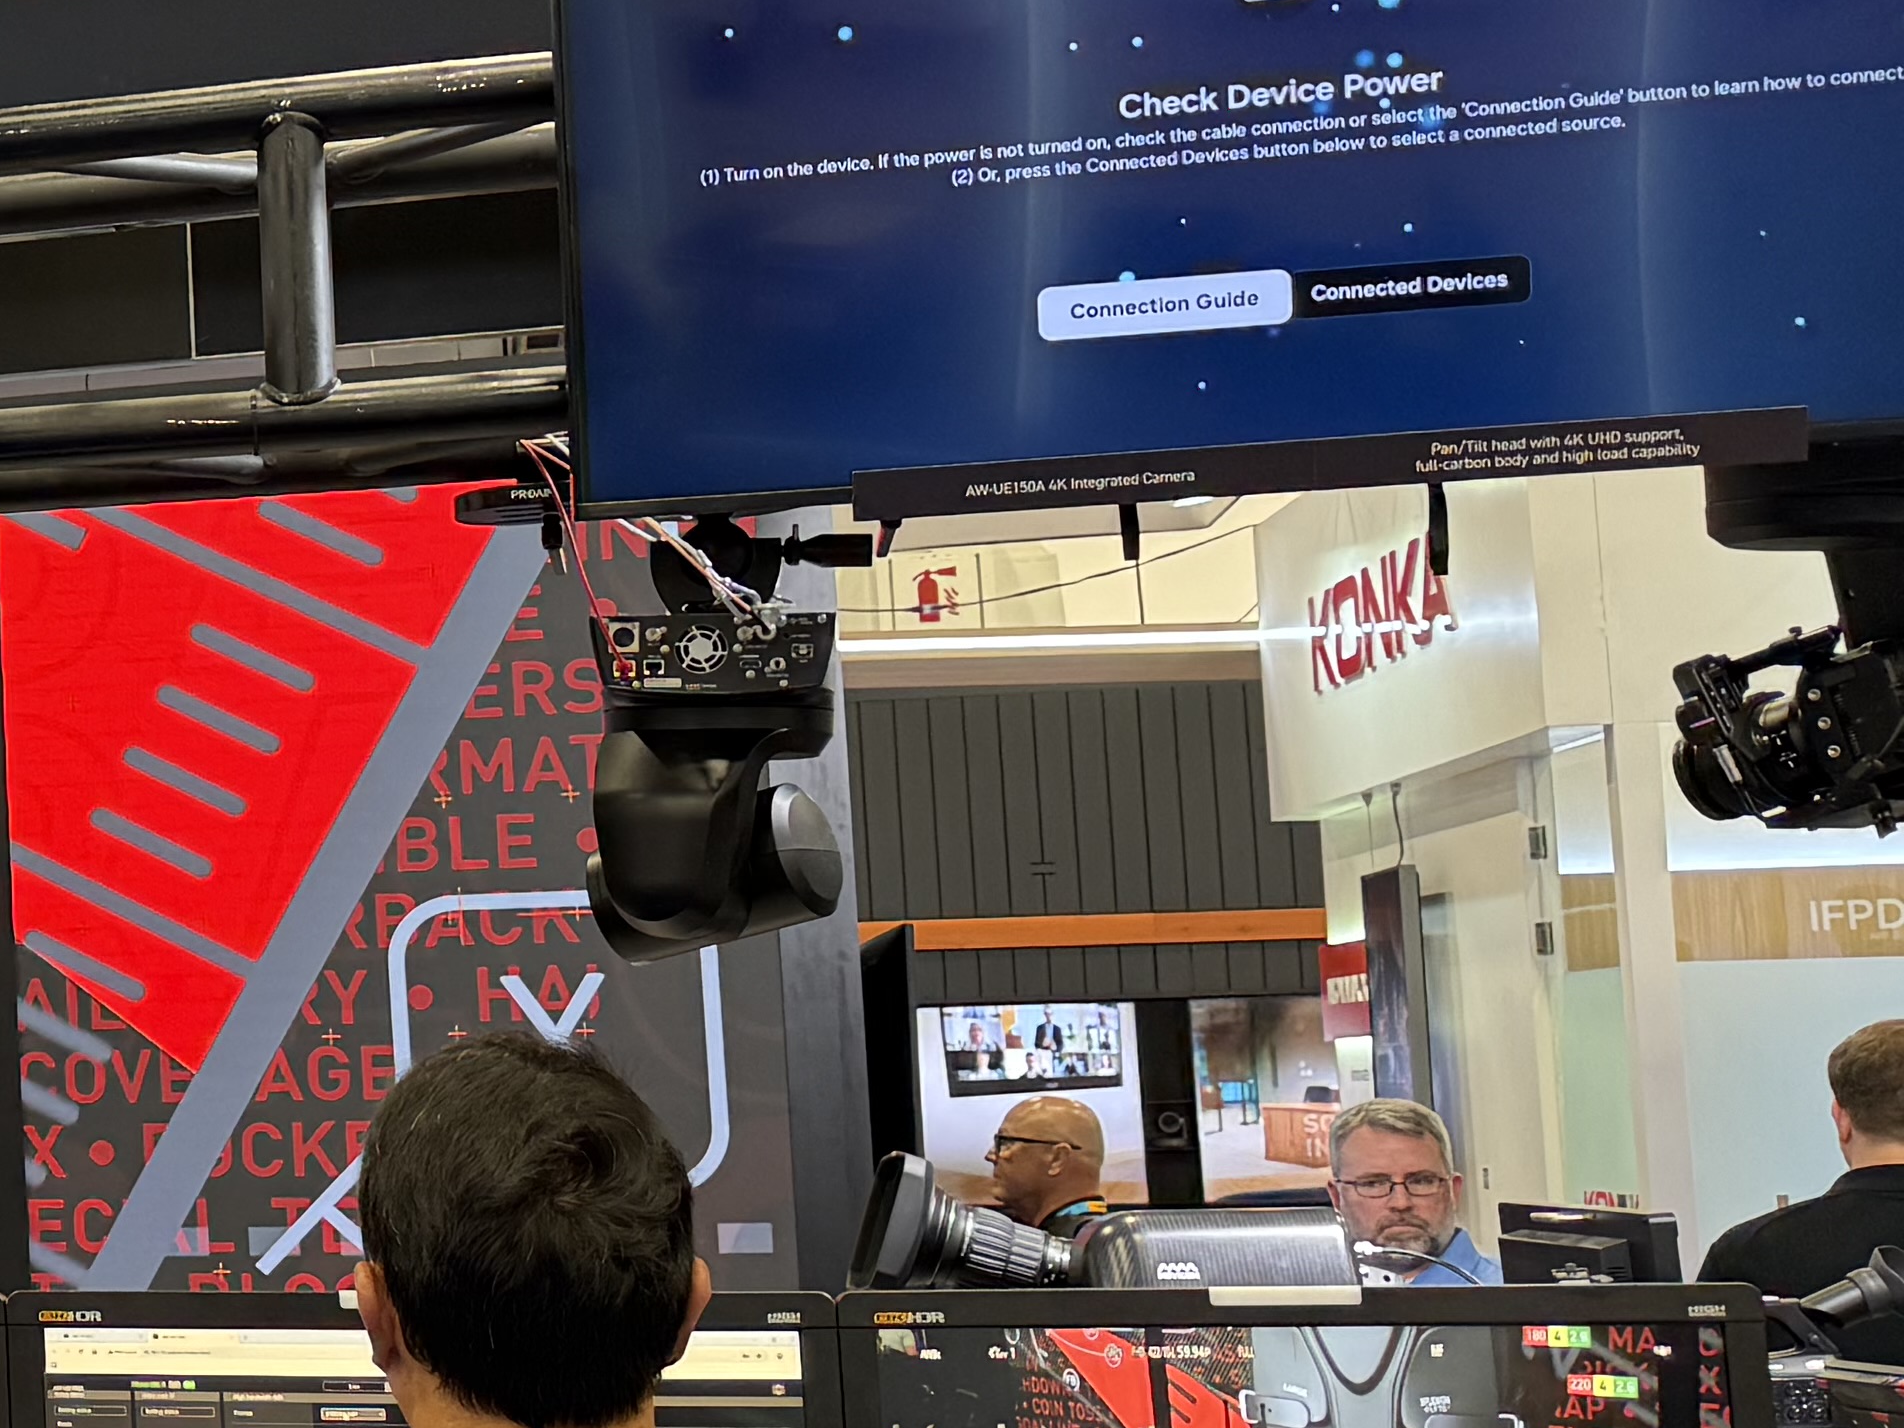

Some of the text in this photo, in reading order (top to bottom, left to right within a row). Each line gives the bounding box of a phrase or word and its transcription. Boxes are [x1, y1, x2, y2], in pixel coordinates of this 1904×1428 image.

[1118, 69, 1444, 120] Check Device Power
[700, 167, 721, 187] (1)
[724, 165, 760, 183] Turn
[763, 167, 784, 179] on
[787, 161, 814, 178] the
[817, 158, 874, 176] device.
[878, 154, 889, 170] If
[892, 151, 920, 168] the
[923, 149, 977, 170] power
[980, 145, 993, 160] is
[996, 142, 1024, 159] not
[1027, 138, 1082, 156] turned
[1085, 137, 1111, 154] on,
[1115, 130, 1166, 149] check
[1169, 127, 1197, 144] the
[1200, 122, 1247, 140] cable
[1251, 114, 1345, 137] connection
[1348, 117, 1368, 129] or
[1371, 107, 1425, 126] select
[1428, 103, 1457, 121] the
[1461, 94, 1566, 118] 'Connection
[1568, 88, 1625, 109] Guide'
[1628, 84, 1687, 106] button
[1691, 81, 1711, 97] to
[1714, 76, 1759, 96] learn
[1762, 73, 1803, 92] how
[1806, 71, 1826, 88] to
[951, 114, 1626, 188] (2) Or, press the Connected Devices button below to select a connected source.
[1070, 270, 1509, 320] Connection Guide Connected Devices
[1414, 440, 1701, 474] full-carbon body and high load capability
[1430, 426, 1685, 458] Pan/Tilt head with 4K UHD support,
[965, 469, 1195, 498] AW-UE150A 4K Integrated Camera
[1032, 1400, 1064, 1418] COIN
